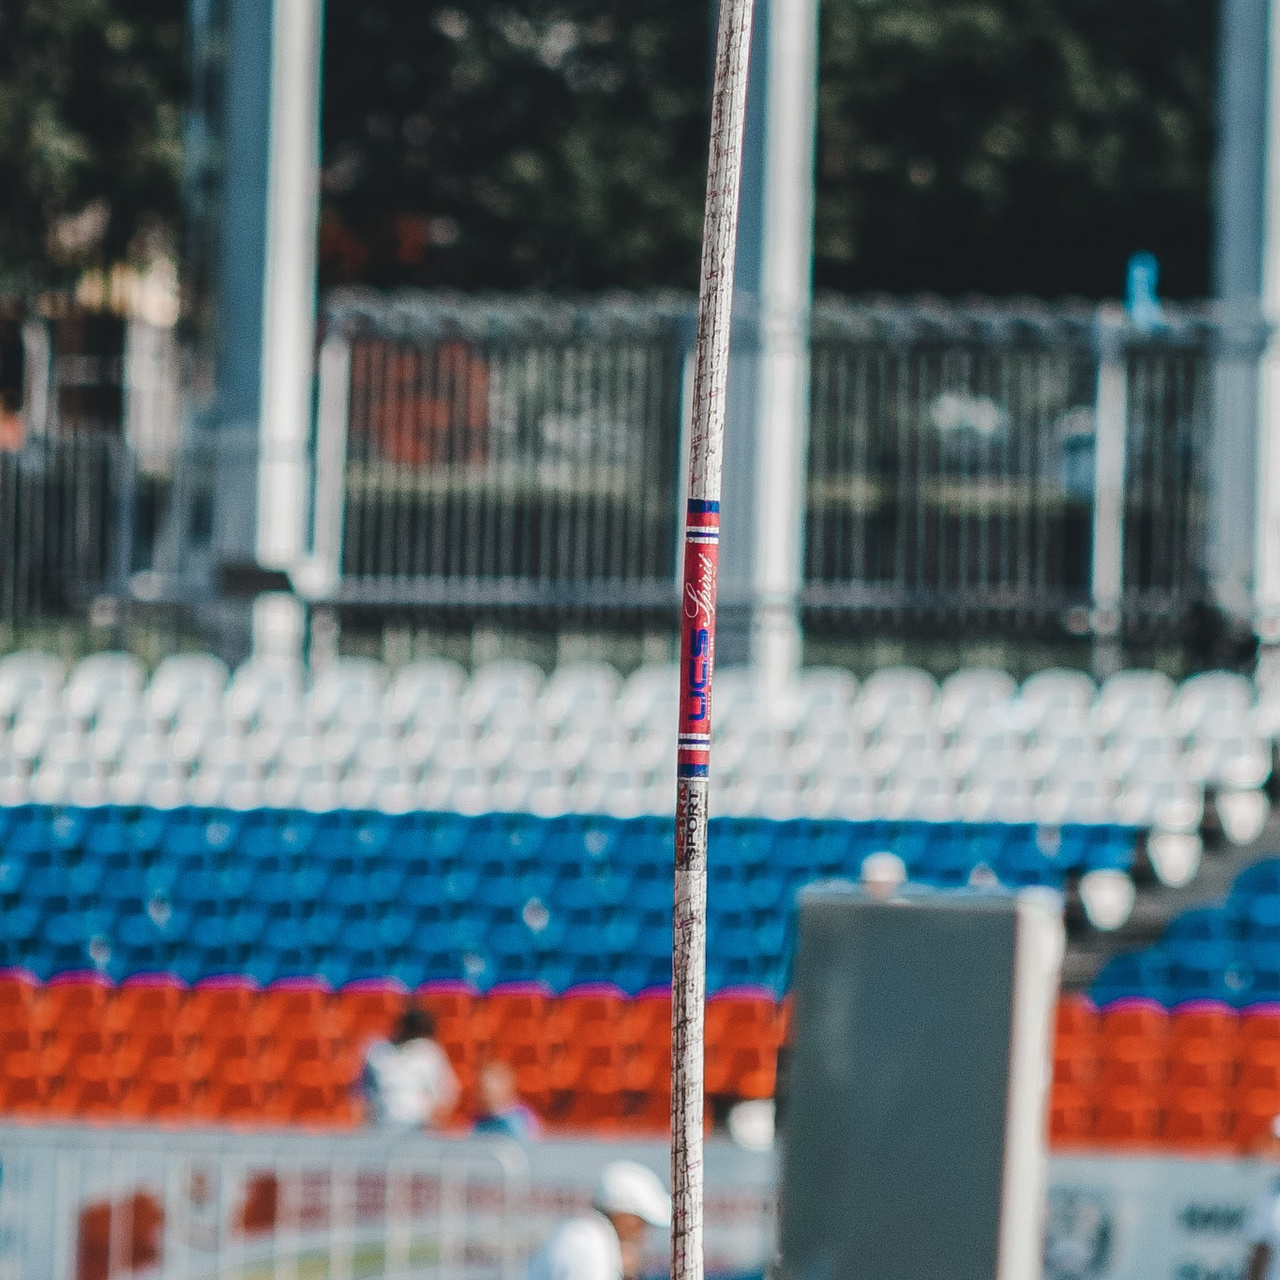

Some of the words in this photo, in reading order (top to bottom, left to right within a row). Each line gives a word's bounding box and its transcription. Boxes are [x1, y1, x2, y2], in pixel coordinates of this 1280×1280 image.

[684, 552, 716, 628] Spirit
[687, 627, 709, 721] UCS
[685, 788, 699, 862] SPORT
